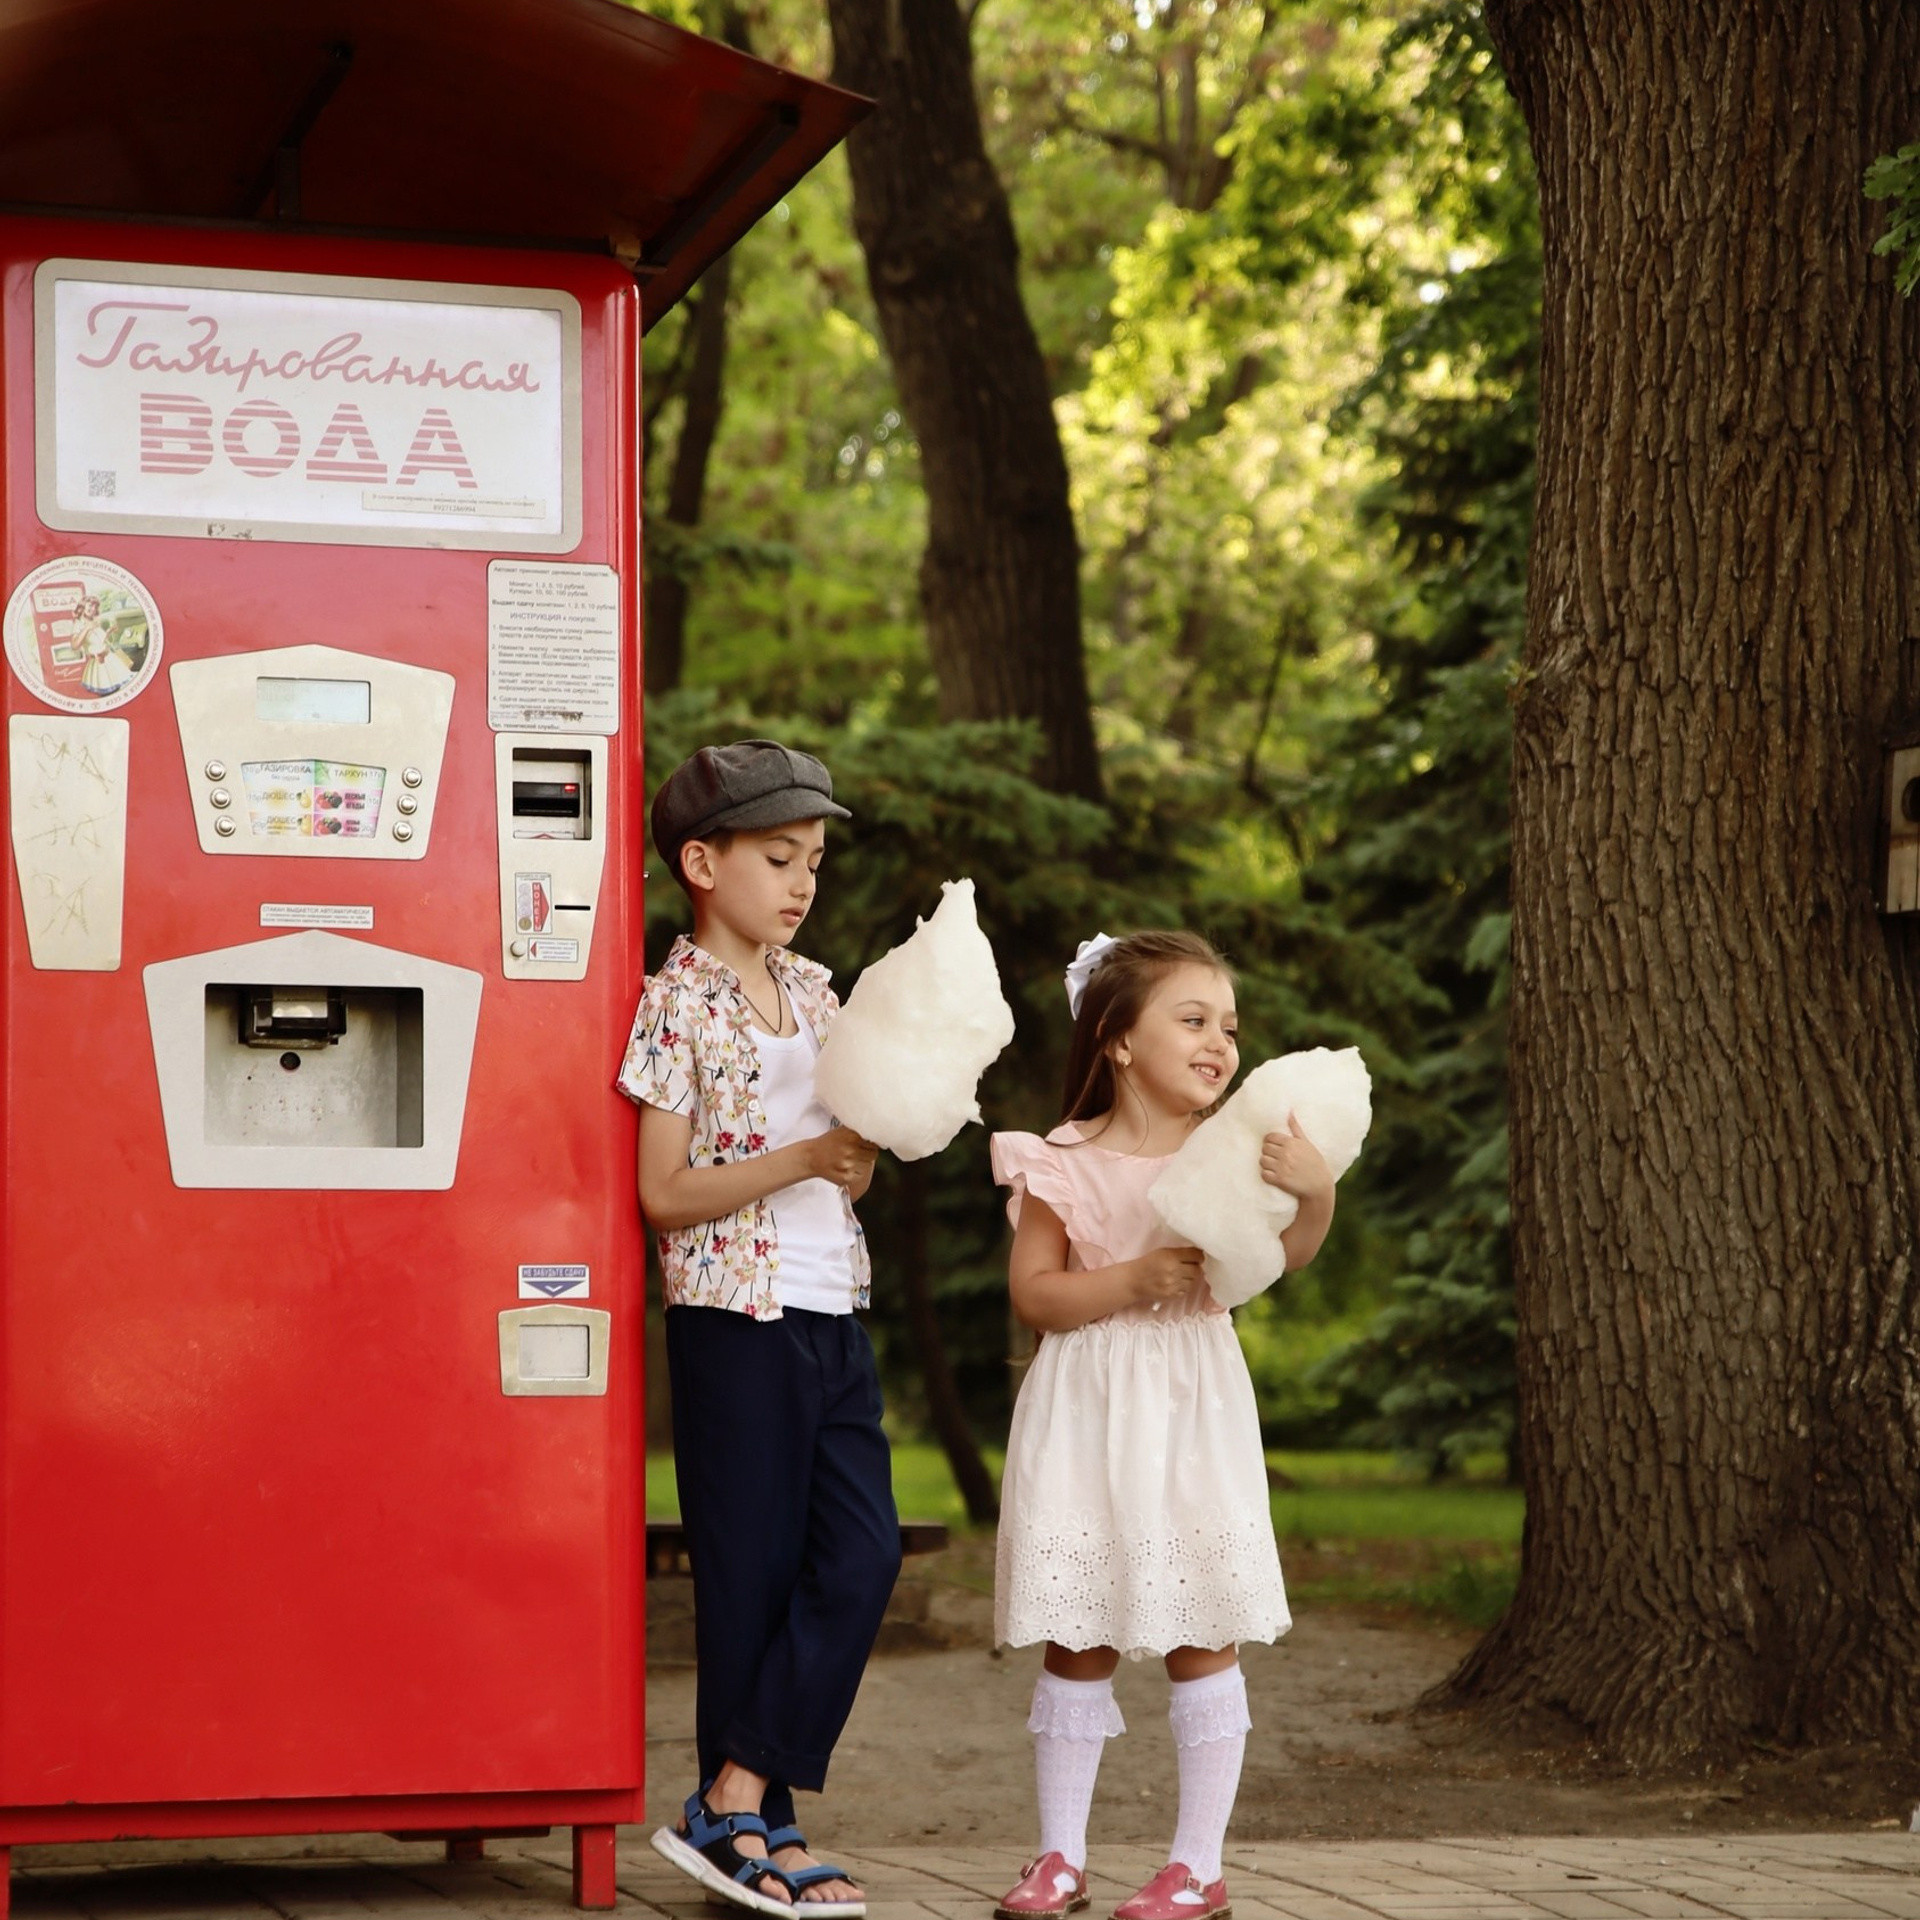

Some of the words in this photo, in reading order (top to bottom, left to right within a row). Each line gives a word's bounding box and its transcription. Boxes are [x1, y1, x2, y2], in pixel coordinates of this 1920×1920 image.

[77, 300, 540, 393] Газированная
[140, 392, 478, 489] ВОДА
[510, 613, 562, 622] ИНСТРУКЦИЯ
[260, 764, 311, 775] ГАЗИРОВКА
[334, 770, 368, 778] ТАРХУН
[262, 792, 295, 801] ДЮШЕС
[266, 816, 296, 824] ДЮШЕС
[534, 884, 542, 931] МОНЕТЫ
[524, 1268, 532, 1277] НЕ
[533, 1268, 564, 1278] ЗАБУДЬТЕ
[564, 1268, 584, 1277] СДАЧУ
